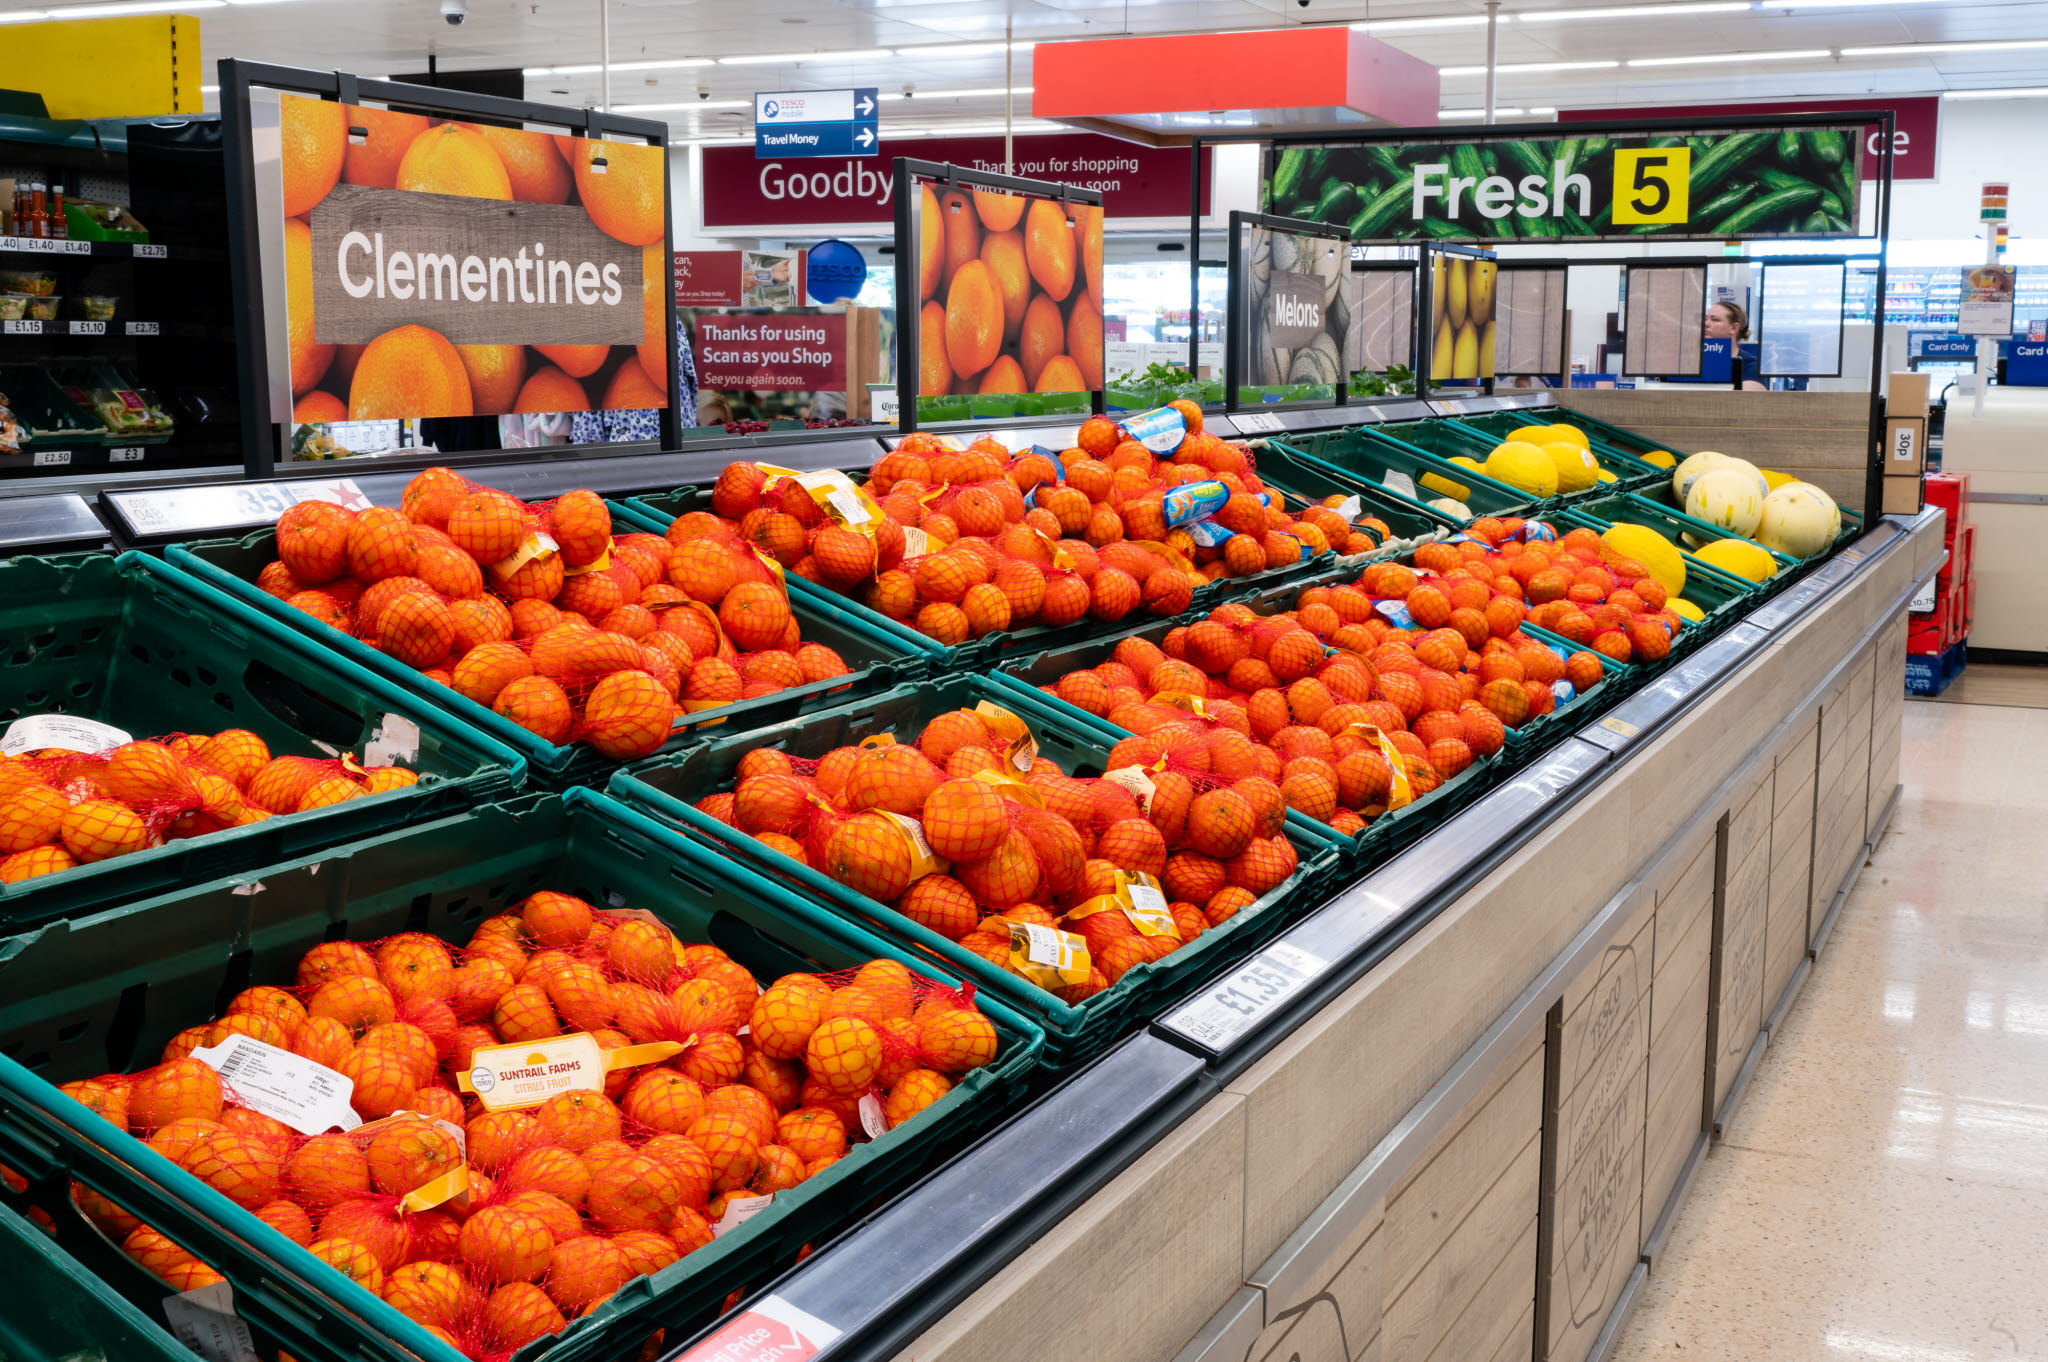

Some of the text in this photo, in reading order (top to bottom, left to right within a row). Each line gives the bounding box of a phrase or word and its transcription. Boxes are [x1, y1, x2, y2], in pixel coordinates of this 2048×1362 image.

[763, 134, 819, 146] Travel Money
[1867, 131, 1909, 155] ce
[1019, 160, 1045, 176] you
[1049, 157, 1067, 172] for
[1072, 156, 1139, 173] shopping
[759, 161, 894, 205] Goodby
[1086, 180, 1121, 191] soon
[1413, 156, 1670, 219] Fresh 5
[0, 238, 17, 248] .40
[29, 240, 54, 250] £1.40
[65, 242, 90, 252] £1.40
[142, 246, 166, 256] £2.75
[674, 257, 692, 266] can,
[337, 231, 623, 306] Clementines
[674, 266, 692, 278] ack,
[809, 264, 863, 276] TESCO
[675, 281, 685, 290] ay
[1275, 293, 1319, 328] Melons
[15, 321, 40, 332] £1.15
[80, 322, 104, 333] £1.10
[135, 323, 158, 333] £2.75
[702, 324, 826, 345] Thanks for using
[1928, 343, 1970, 352] Card Only
[2016, 346, 2044, 356] Card
[703, 347, 833, 367] Scan as you Shop
[704, 373, 805, 387] See you again soon.
[882, 402, 899, 410] Coro
[1897, 434, 1911, 456] 30p
[45, 452, 70, 463] £2.50
[125, 449, 138, 460] £3
[1215, 966, 1290, 1016] £1.35
[1591, 975, 1622, 1050] TESCO
[500, 1060, 581, 1082] SUNTRAIL FARMS
[514, 1076, 572, 1095] CITRUS FRUIT
[1579, 1088, 1630, 1233] QUALITY
[1593, 1145, 1626, 1246] TASTE
[724, 1328, 771, 1357] Price
